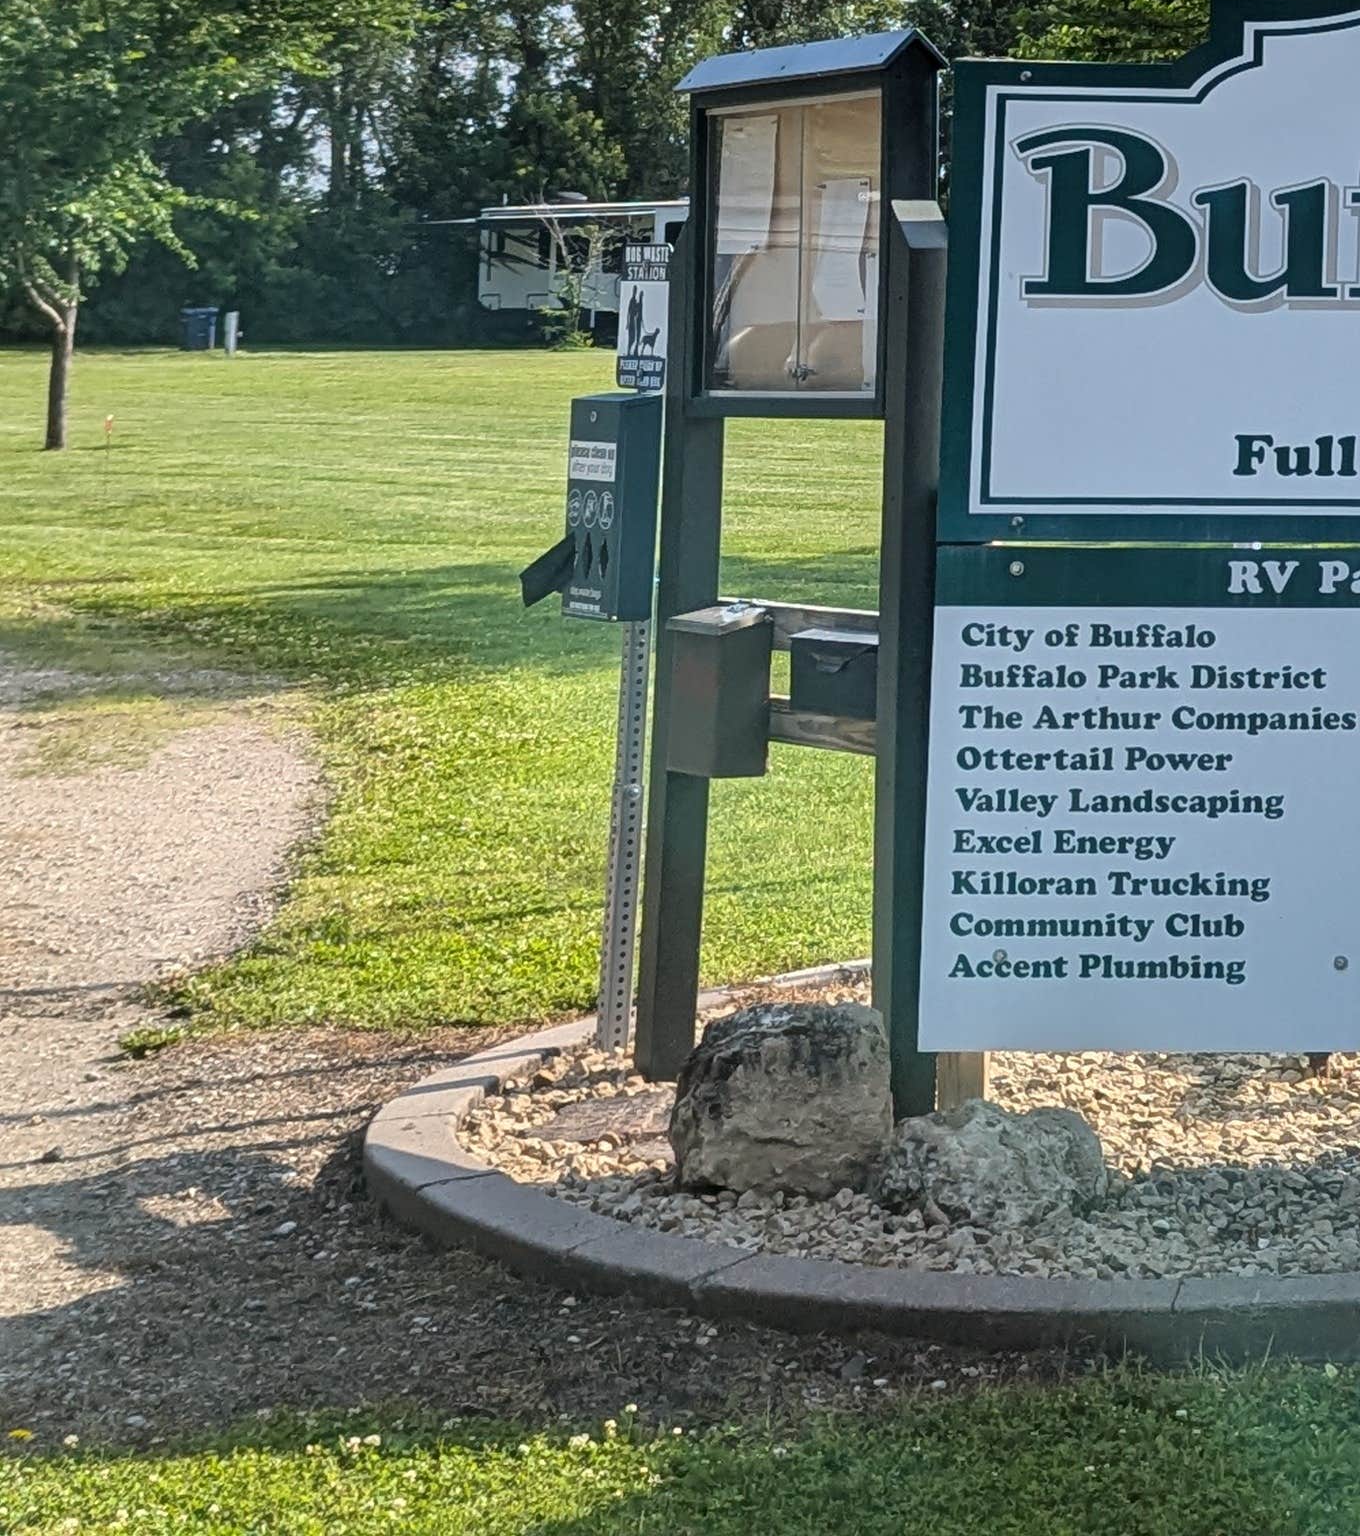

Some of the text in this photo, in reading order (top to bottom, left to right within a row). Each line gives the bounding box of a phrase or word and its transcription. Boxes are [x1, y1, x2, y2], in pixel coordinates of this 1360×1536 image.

[625, 246, 670, 263] DOG WASTE
[627, 266, 667, 281] STATION
[1232, 434, 1358, 477] Full
[1227, 560, 1300, 594] RV
[961, 622, 1216, 653] City of Buffalo
[959, 663, 1327, 690] Buffalo Park District
[958, 704, 1357, 736] The Arthur Companies
[956, 746, 1233, 772] Ottertail Power
[954, 787, 1285, 820] Valley Landscaping
[952, 829, 1177, 861] Excel Energy
[951, 870, 1271, 903] Killoran Trucking
[949, 912, 1245, 943] Community Club
[948, 953, 1246, 985] Accent Plumbing
